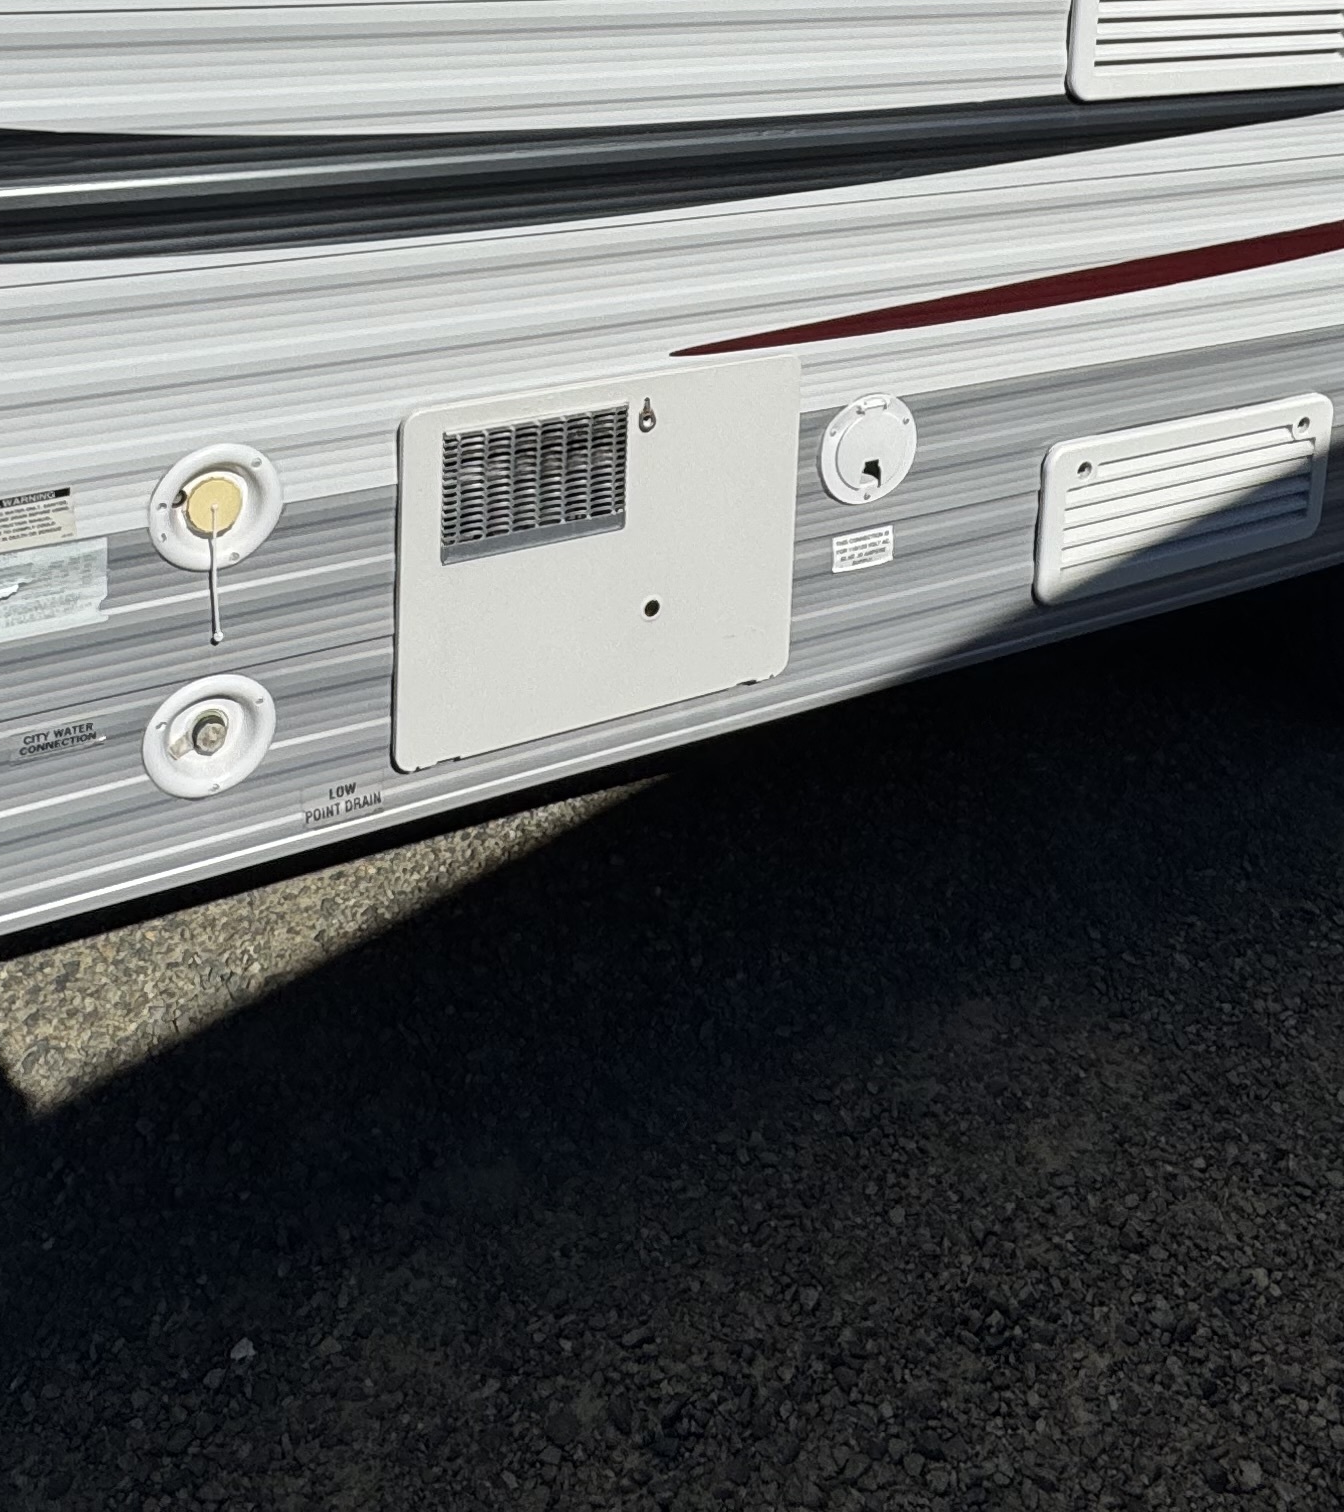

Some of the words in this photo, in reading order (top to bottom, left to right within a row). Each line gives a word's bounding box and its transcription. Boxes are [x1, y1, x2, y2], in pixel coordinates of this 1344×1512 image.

[1, 490, 56, 508] WARNING
[19, 731, 97, 756] CONNECTION
[23, 731, 50, 746] CITY
[53, 722, 94, 738] WATER
[328, 782, 357, 800] LOW
[305, 802, 341, 824] POINT
[345, 791, 382, 813] DRAIN
